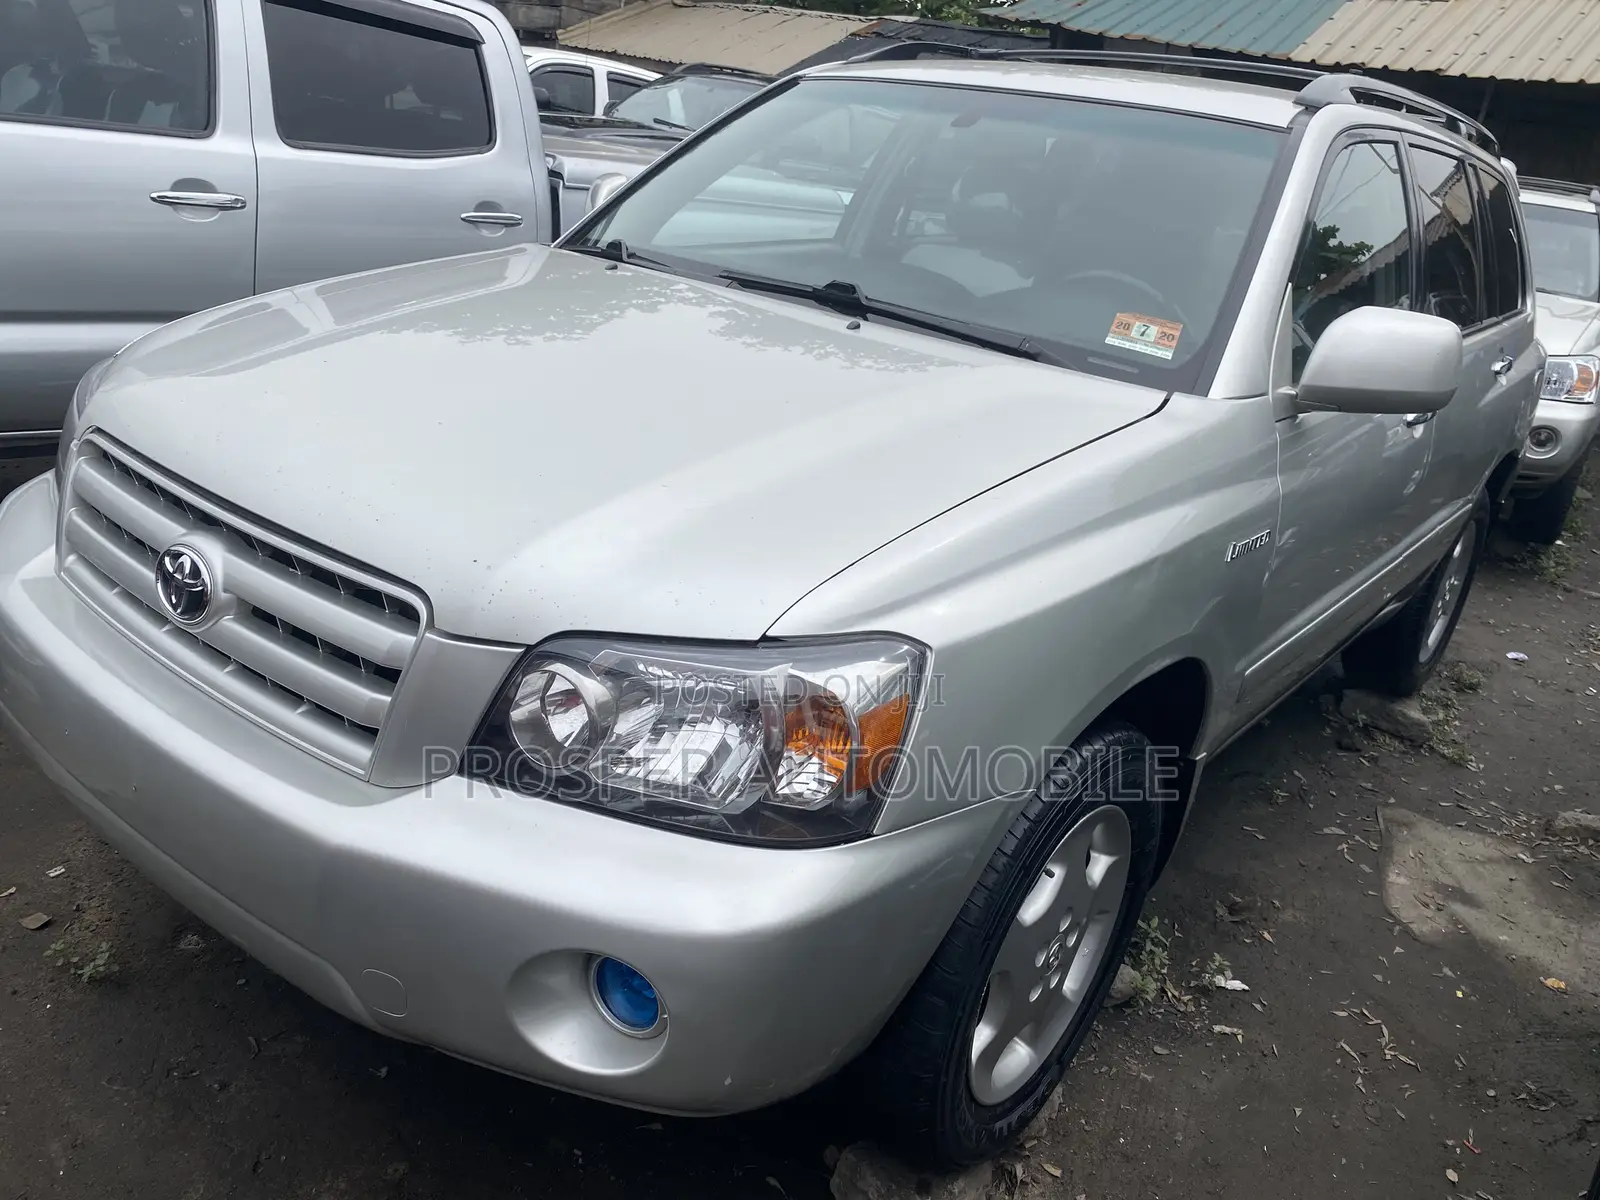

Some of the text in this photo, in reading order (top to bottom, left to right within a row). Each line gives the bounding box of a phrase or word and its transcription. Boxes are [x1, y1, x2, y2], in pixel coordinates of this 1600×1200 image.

[1115, 321, 1131, 332] 20
[1139, 323, 1151, 337] 7
[1160, 331, 1175, 343] 20
